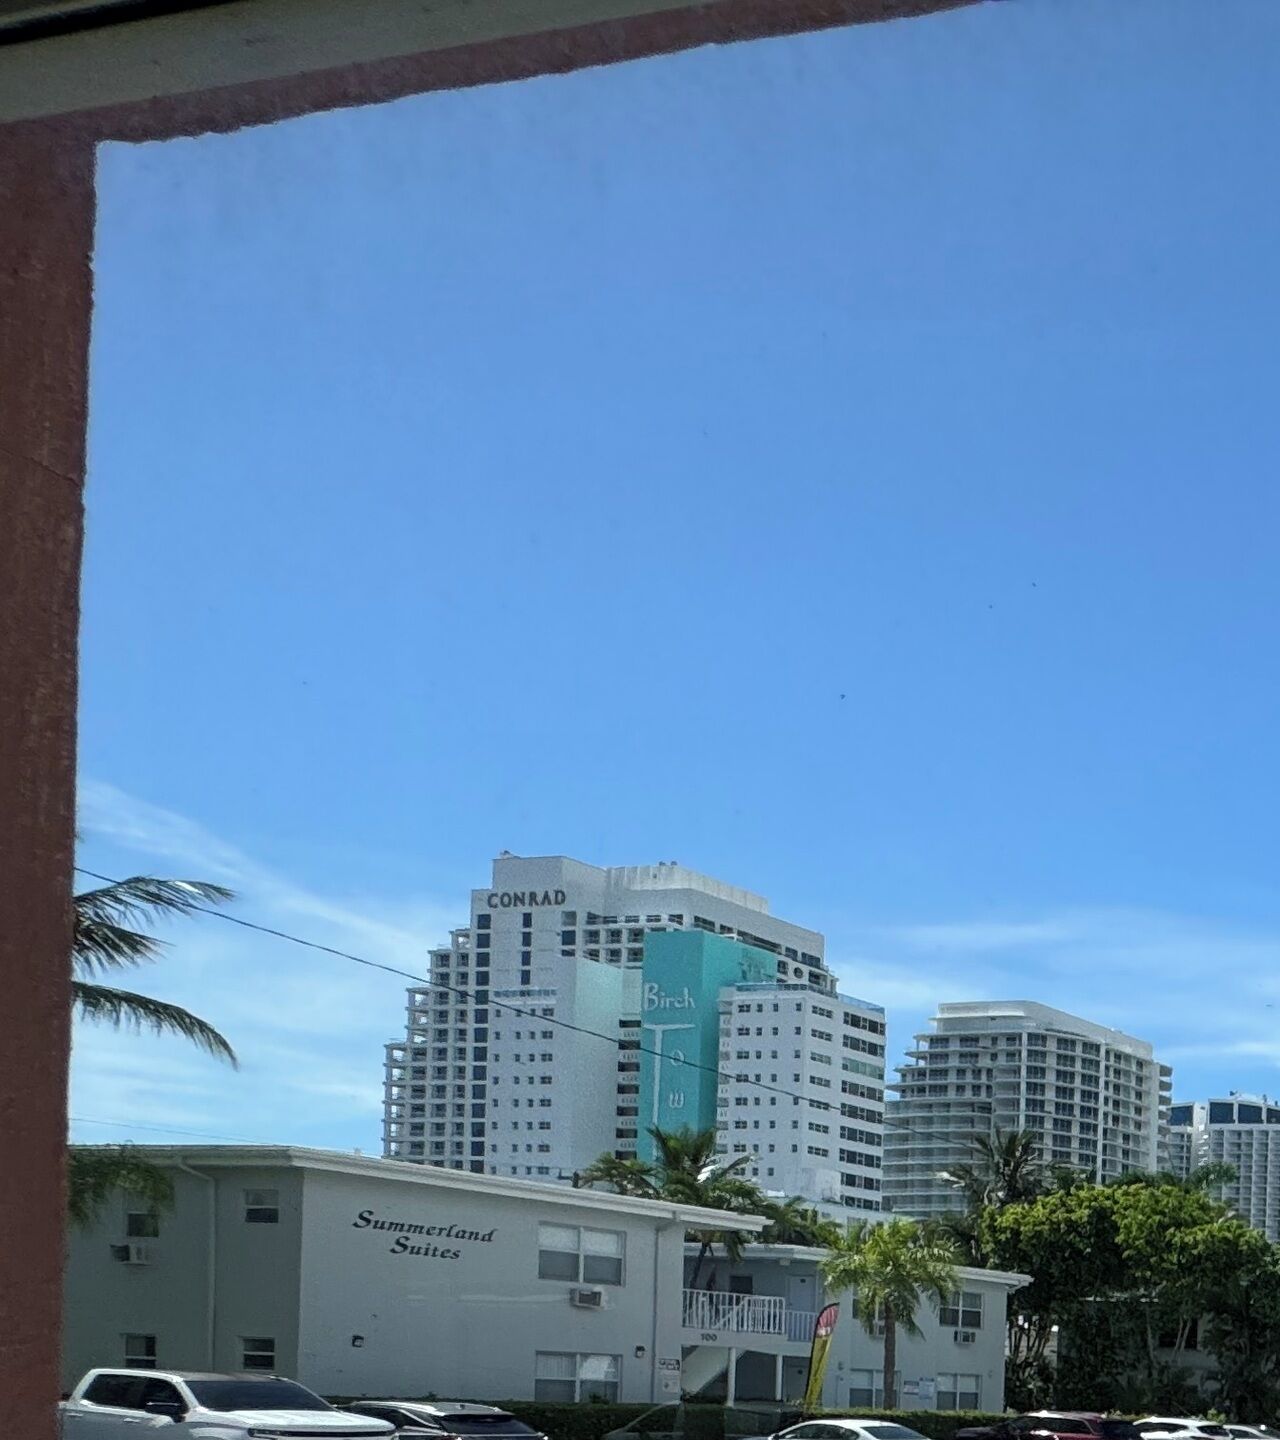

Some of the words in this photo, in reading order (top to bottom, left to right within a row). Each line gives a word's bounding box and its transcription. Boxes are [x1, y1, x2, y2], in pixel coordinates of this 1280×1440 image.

[487, 889, 566, 909] CONRAD
[643, 982, 696, 1012] Birch
[352, 1209, 498, 1243] Summerland
[389, 1235, 462, 1260] Suites
